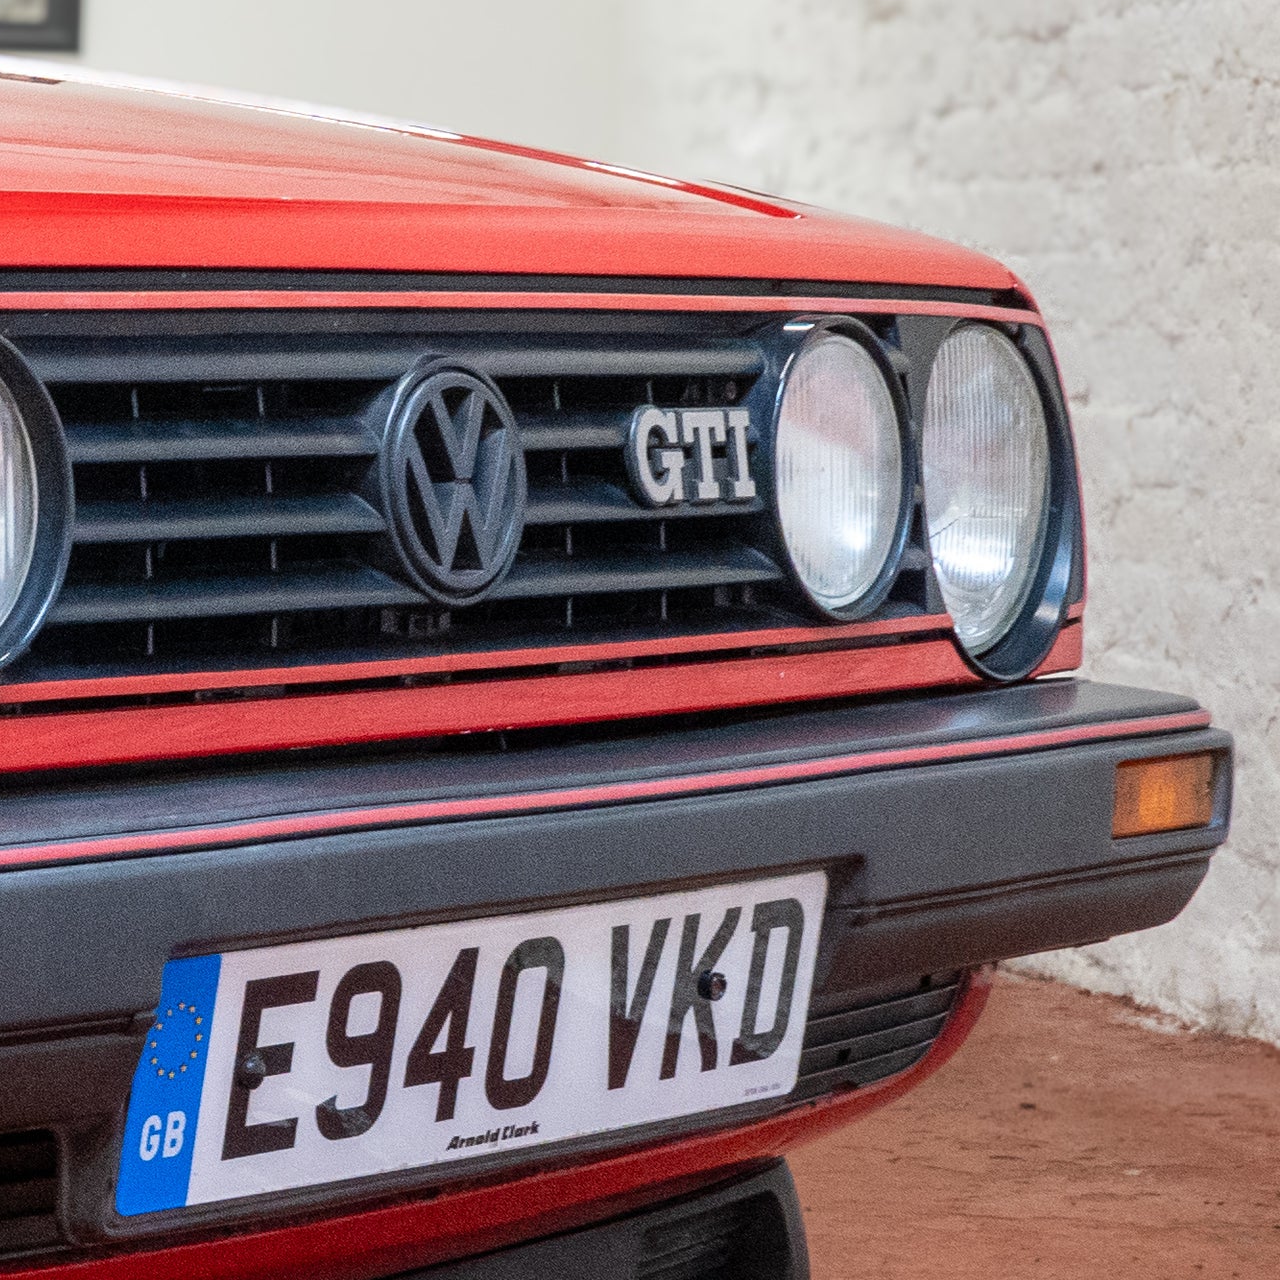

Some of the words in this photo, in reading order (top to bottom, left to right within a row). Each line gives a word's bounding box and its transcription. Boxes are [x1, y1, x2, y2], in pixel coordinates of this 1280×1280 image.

[385, 365, 522, 600] VW
[632, 405, 757, 508] GTI
[220, 934, 566, 1161] E940
[607, 897, 805, 1091] VKD
[140, 1110, 187, 1161] GB
[446, 1127, 501, 1151] Arnold
[501, 1120, 541, 1141] Clark
